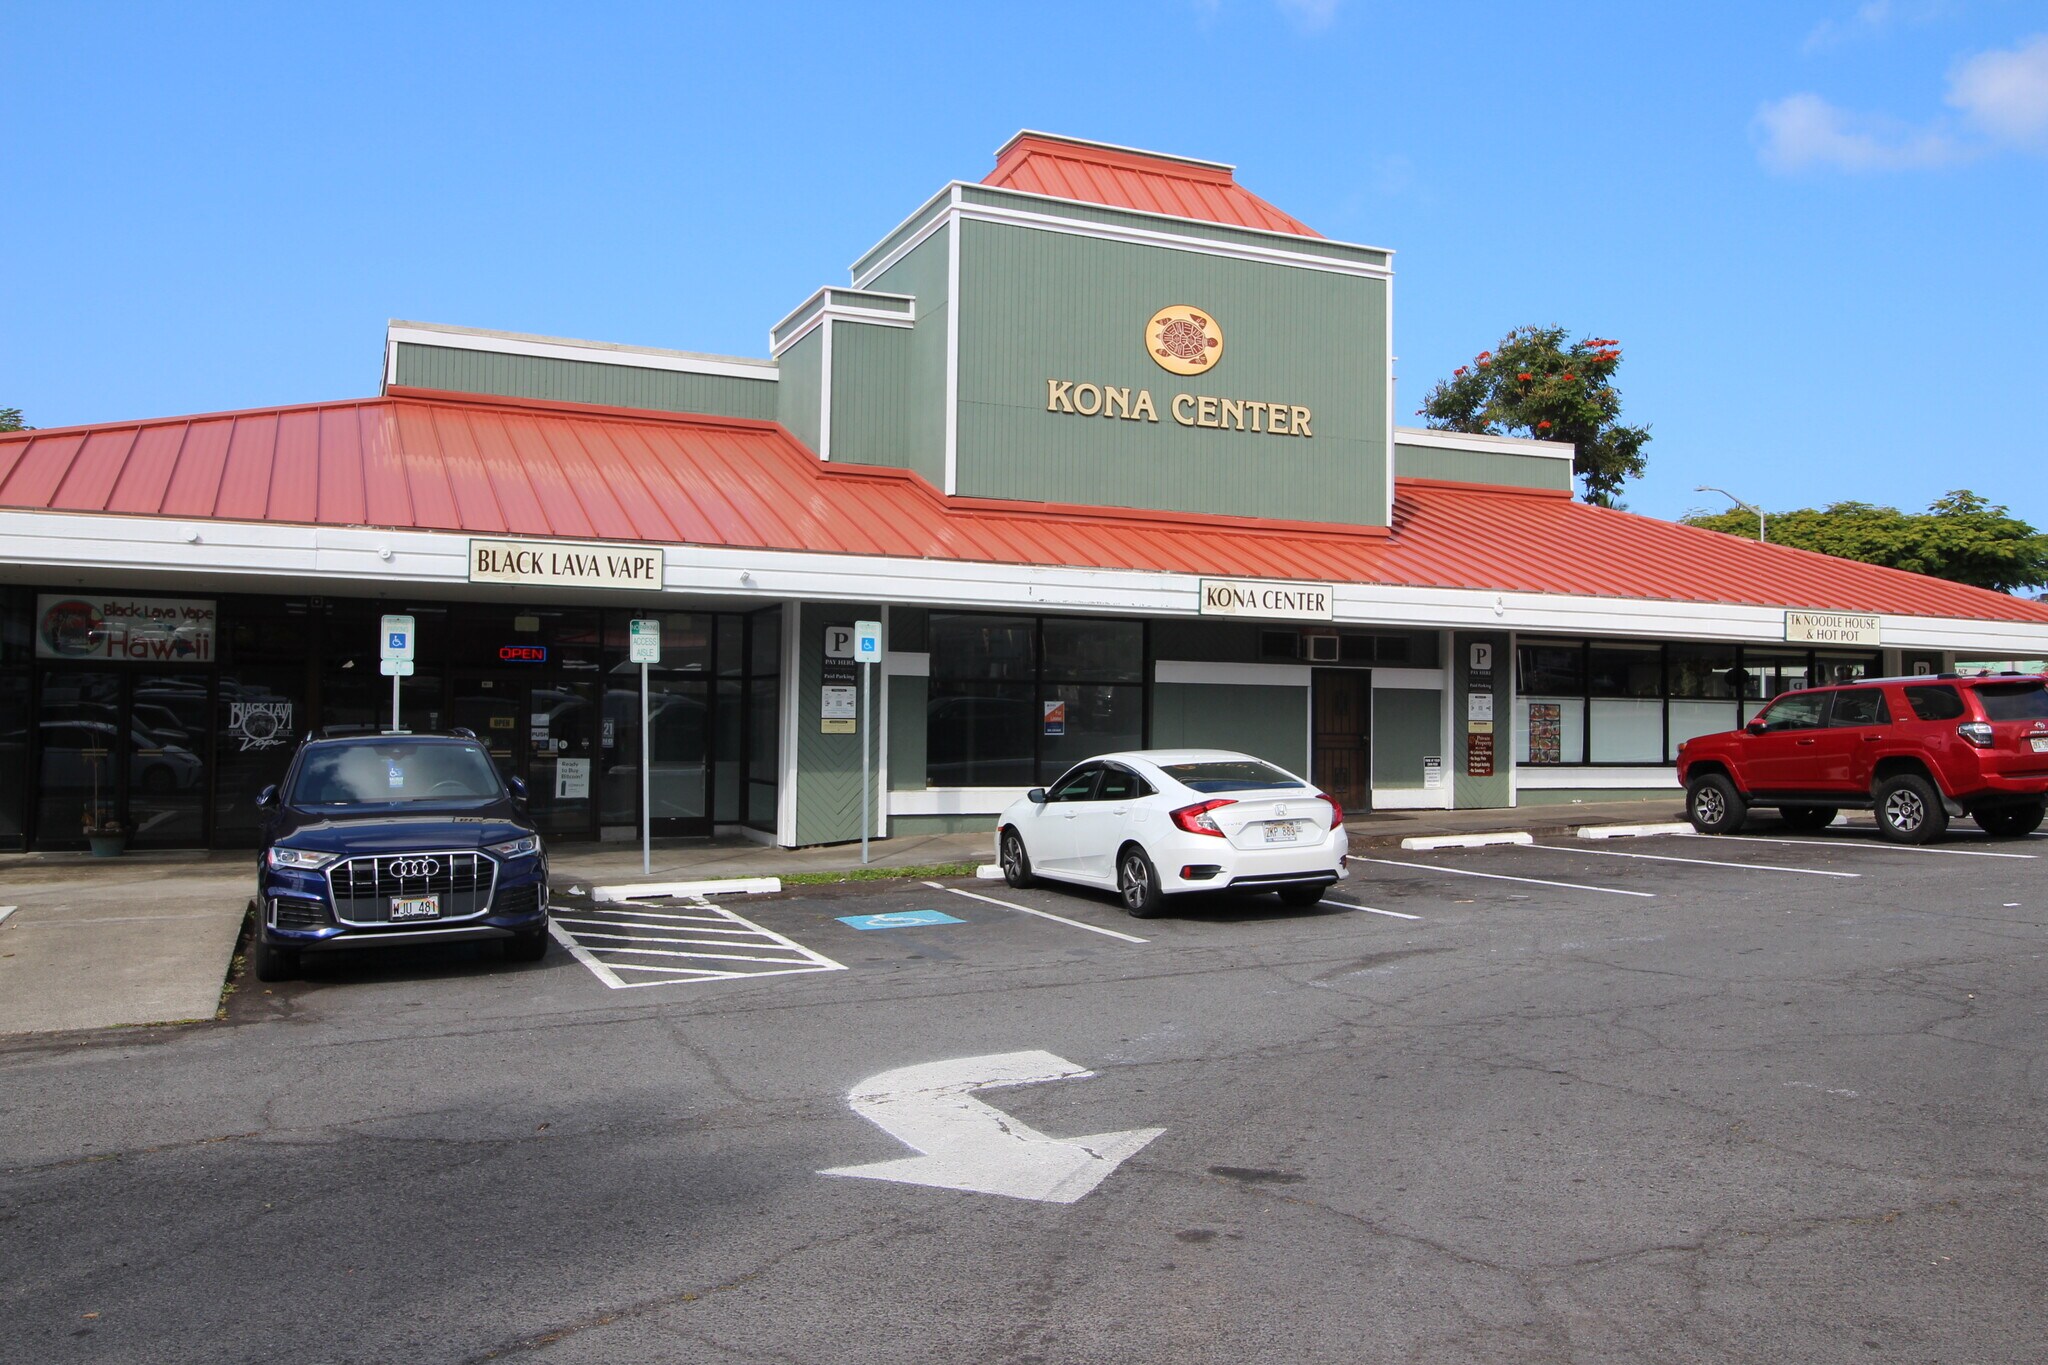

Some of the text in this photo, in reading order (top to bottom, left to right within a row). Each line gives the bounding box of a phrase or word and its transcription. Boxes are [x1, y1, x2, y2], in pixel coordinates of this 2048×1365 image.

[1047, 379, 1312, 437] KONA CENTER
[477, 549, 655, 580] BLACK LAVA VAPE
[1207, 587, 1325, 611] KONA CENTER
[103, 602, 214, 622] Black Lava Vape
[1791, 614, 1876, 630] TK NOODLE HOUSE
[633, 638, 657, 646] ACCESS
[833, 632, 849, 652] P
[1806, 628, 1860, 642] & HOT POT
[499, 647, 543, 660] OPEN
[636, 648, 654, 657] AISLE
[1476, 648, 1487, 665] P
[836, 673, 855, 681] Parking
[228, 702, 293, 730] BLACK LAVA
[603, 722, 614, 736] 21
[237, 737, 287, 752] Vape
[418, 900, 436, 913] 481
